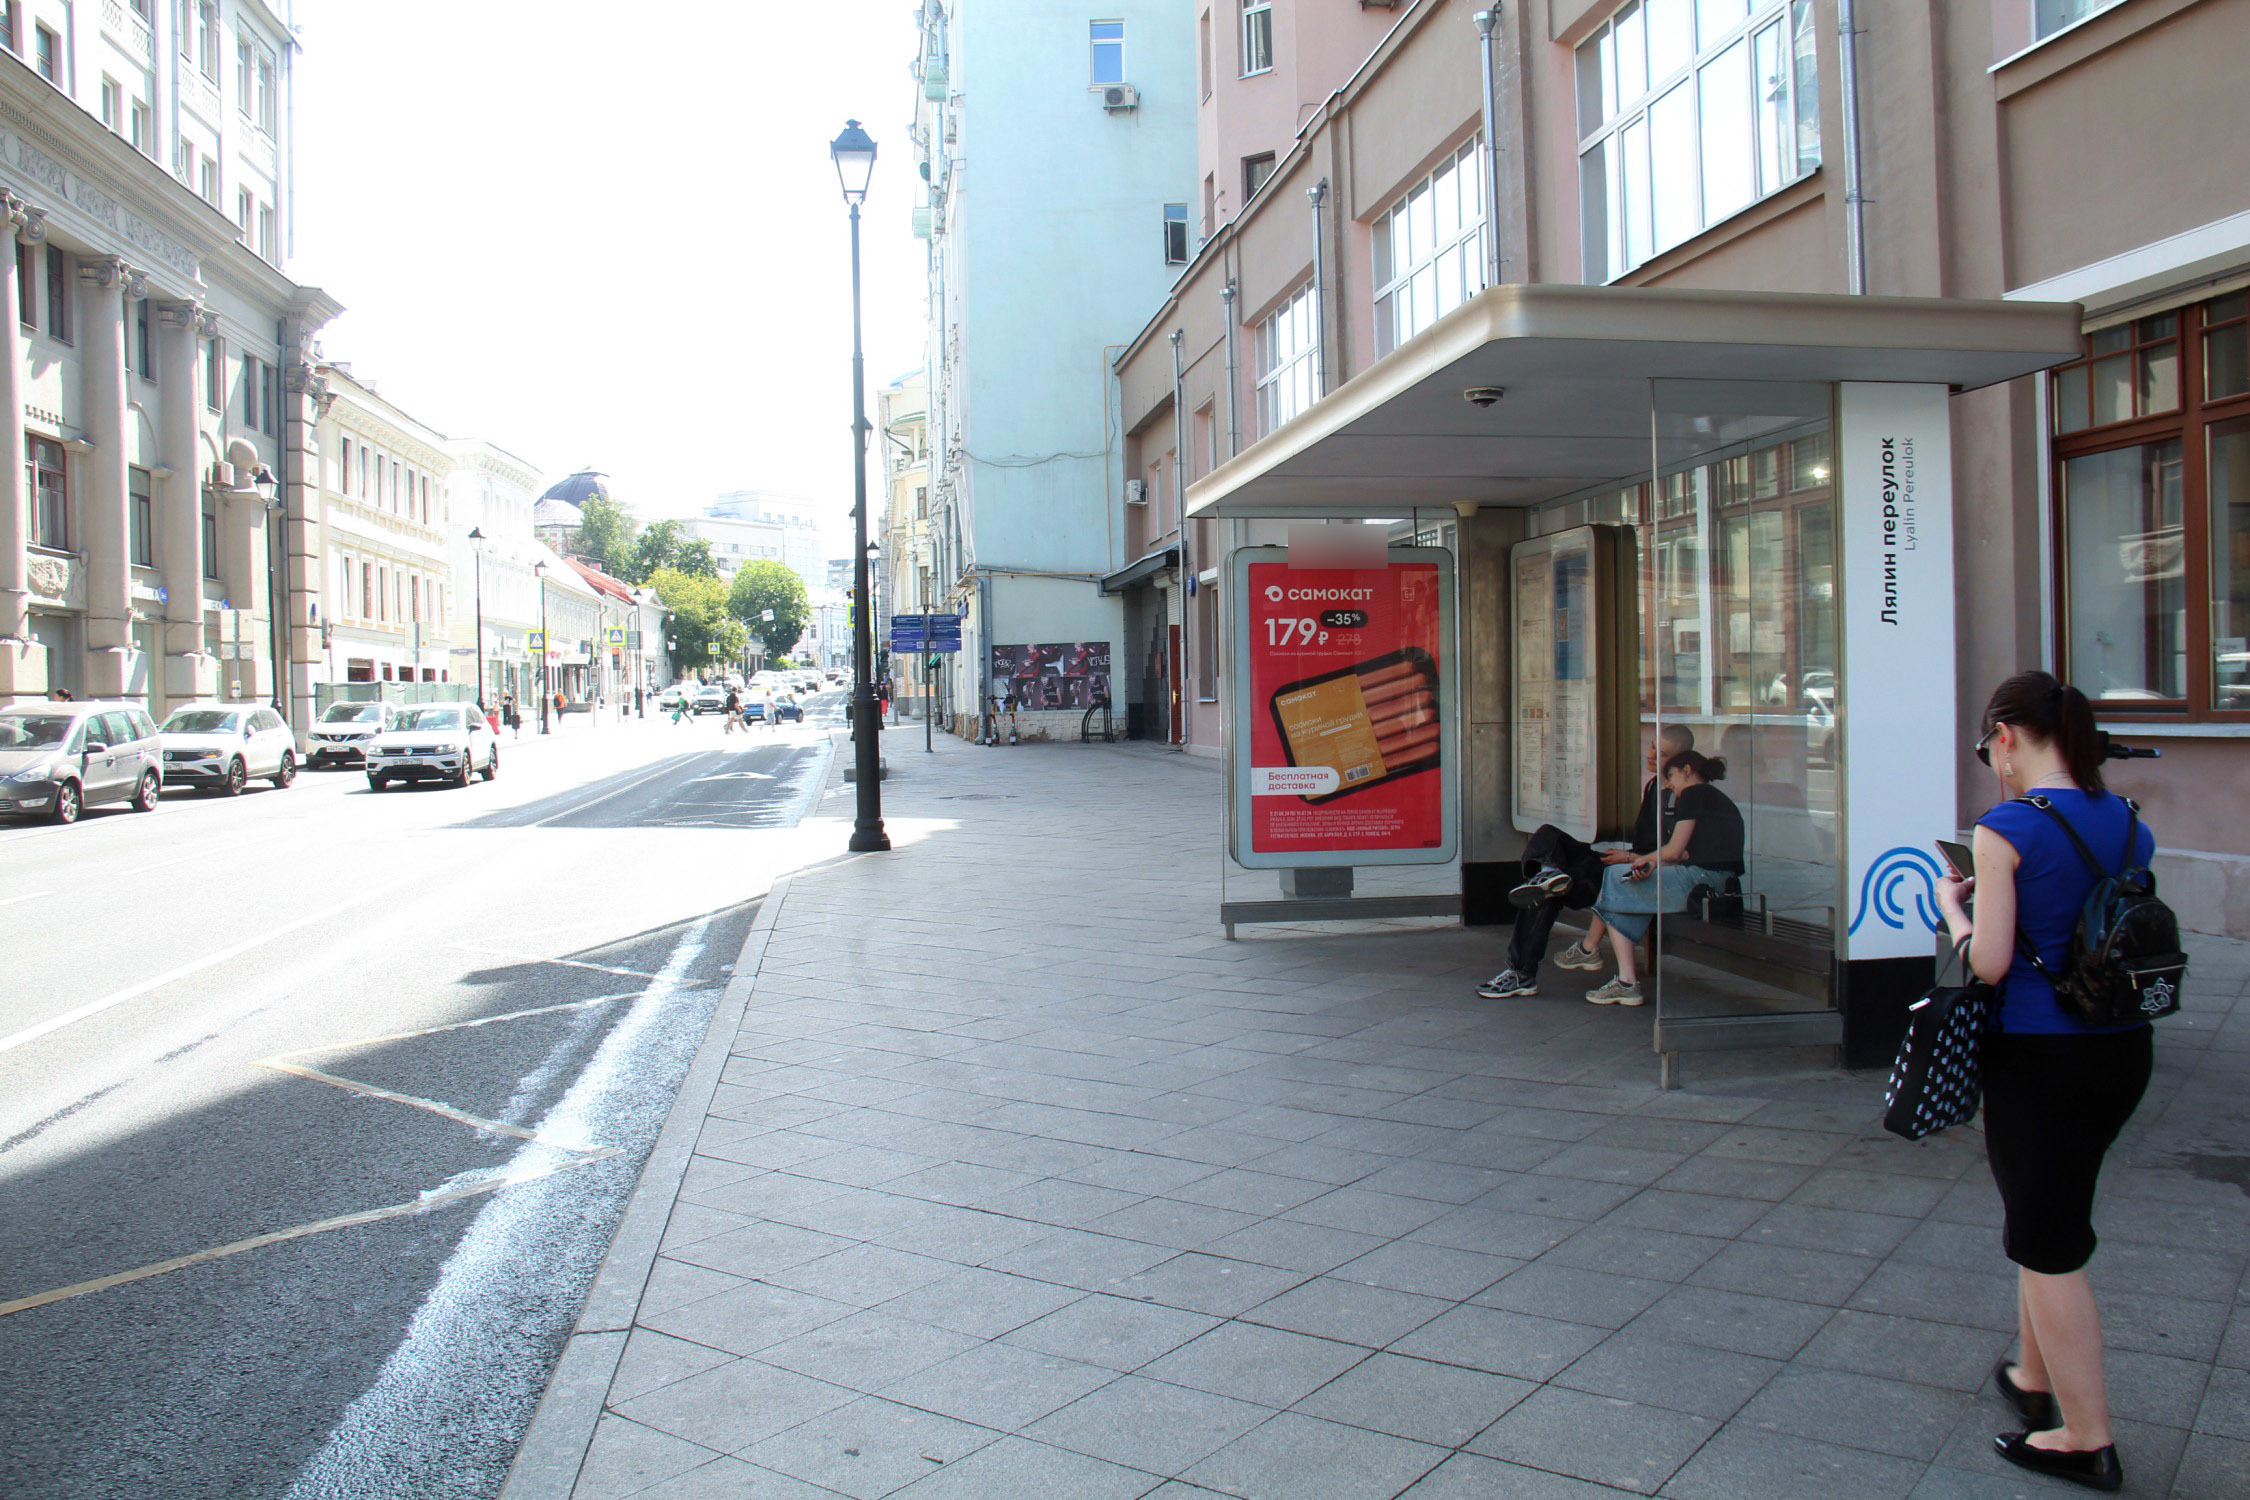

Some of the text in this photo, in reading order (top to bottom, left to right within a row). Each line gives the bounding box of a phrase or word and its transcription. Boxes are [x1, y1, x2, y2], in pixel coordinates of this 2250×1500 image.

[1901, 437, 1918, 551] Lyalin Pereulok
[1881, 437, 1899, 626] Лялин переулок
[1287, 588, 1374, 601] самокат
[1280, 691, 1317, 706] самокат
[1301, 720, 1335, 736] куриной
[1335, 711, 1363, 726] грудки
[1268, 771, 1329, 781] Бесплатная
[1268, 782, 1316, 791] доставка
